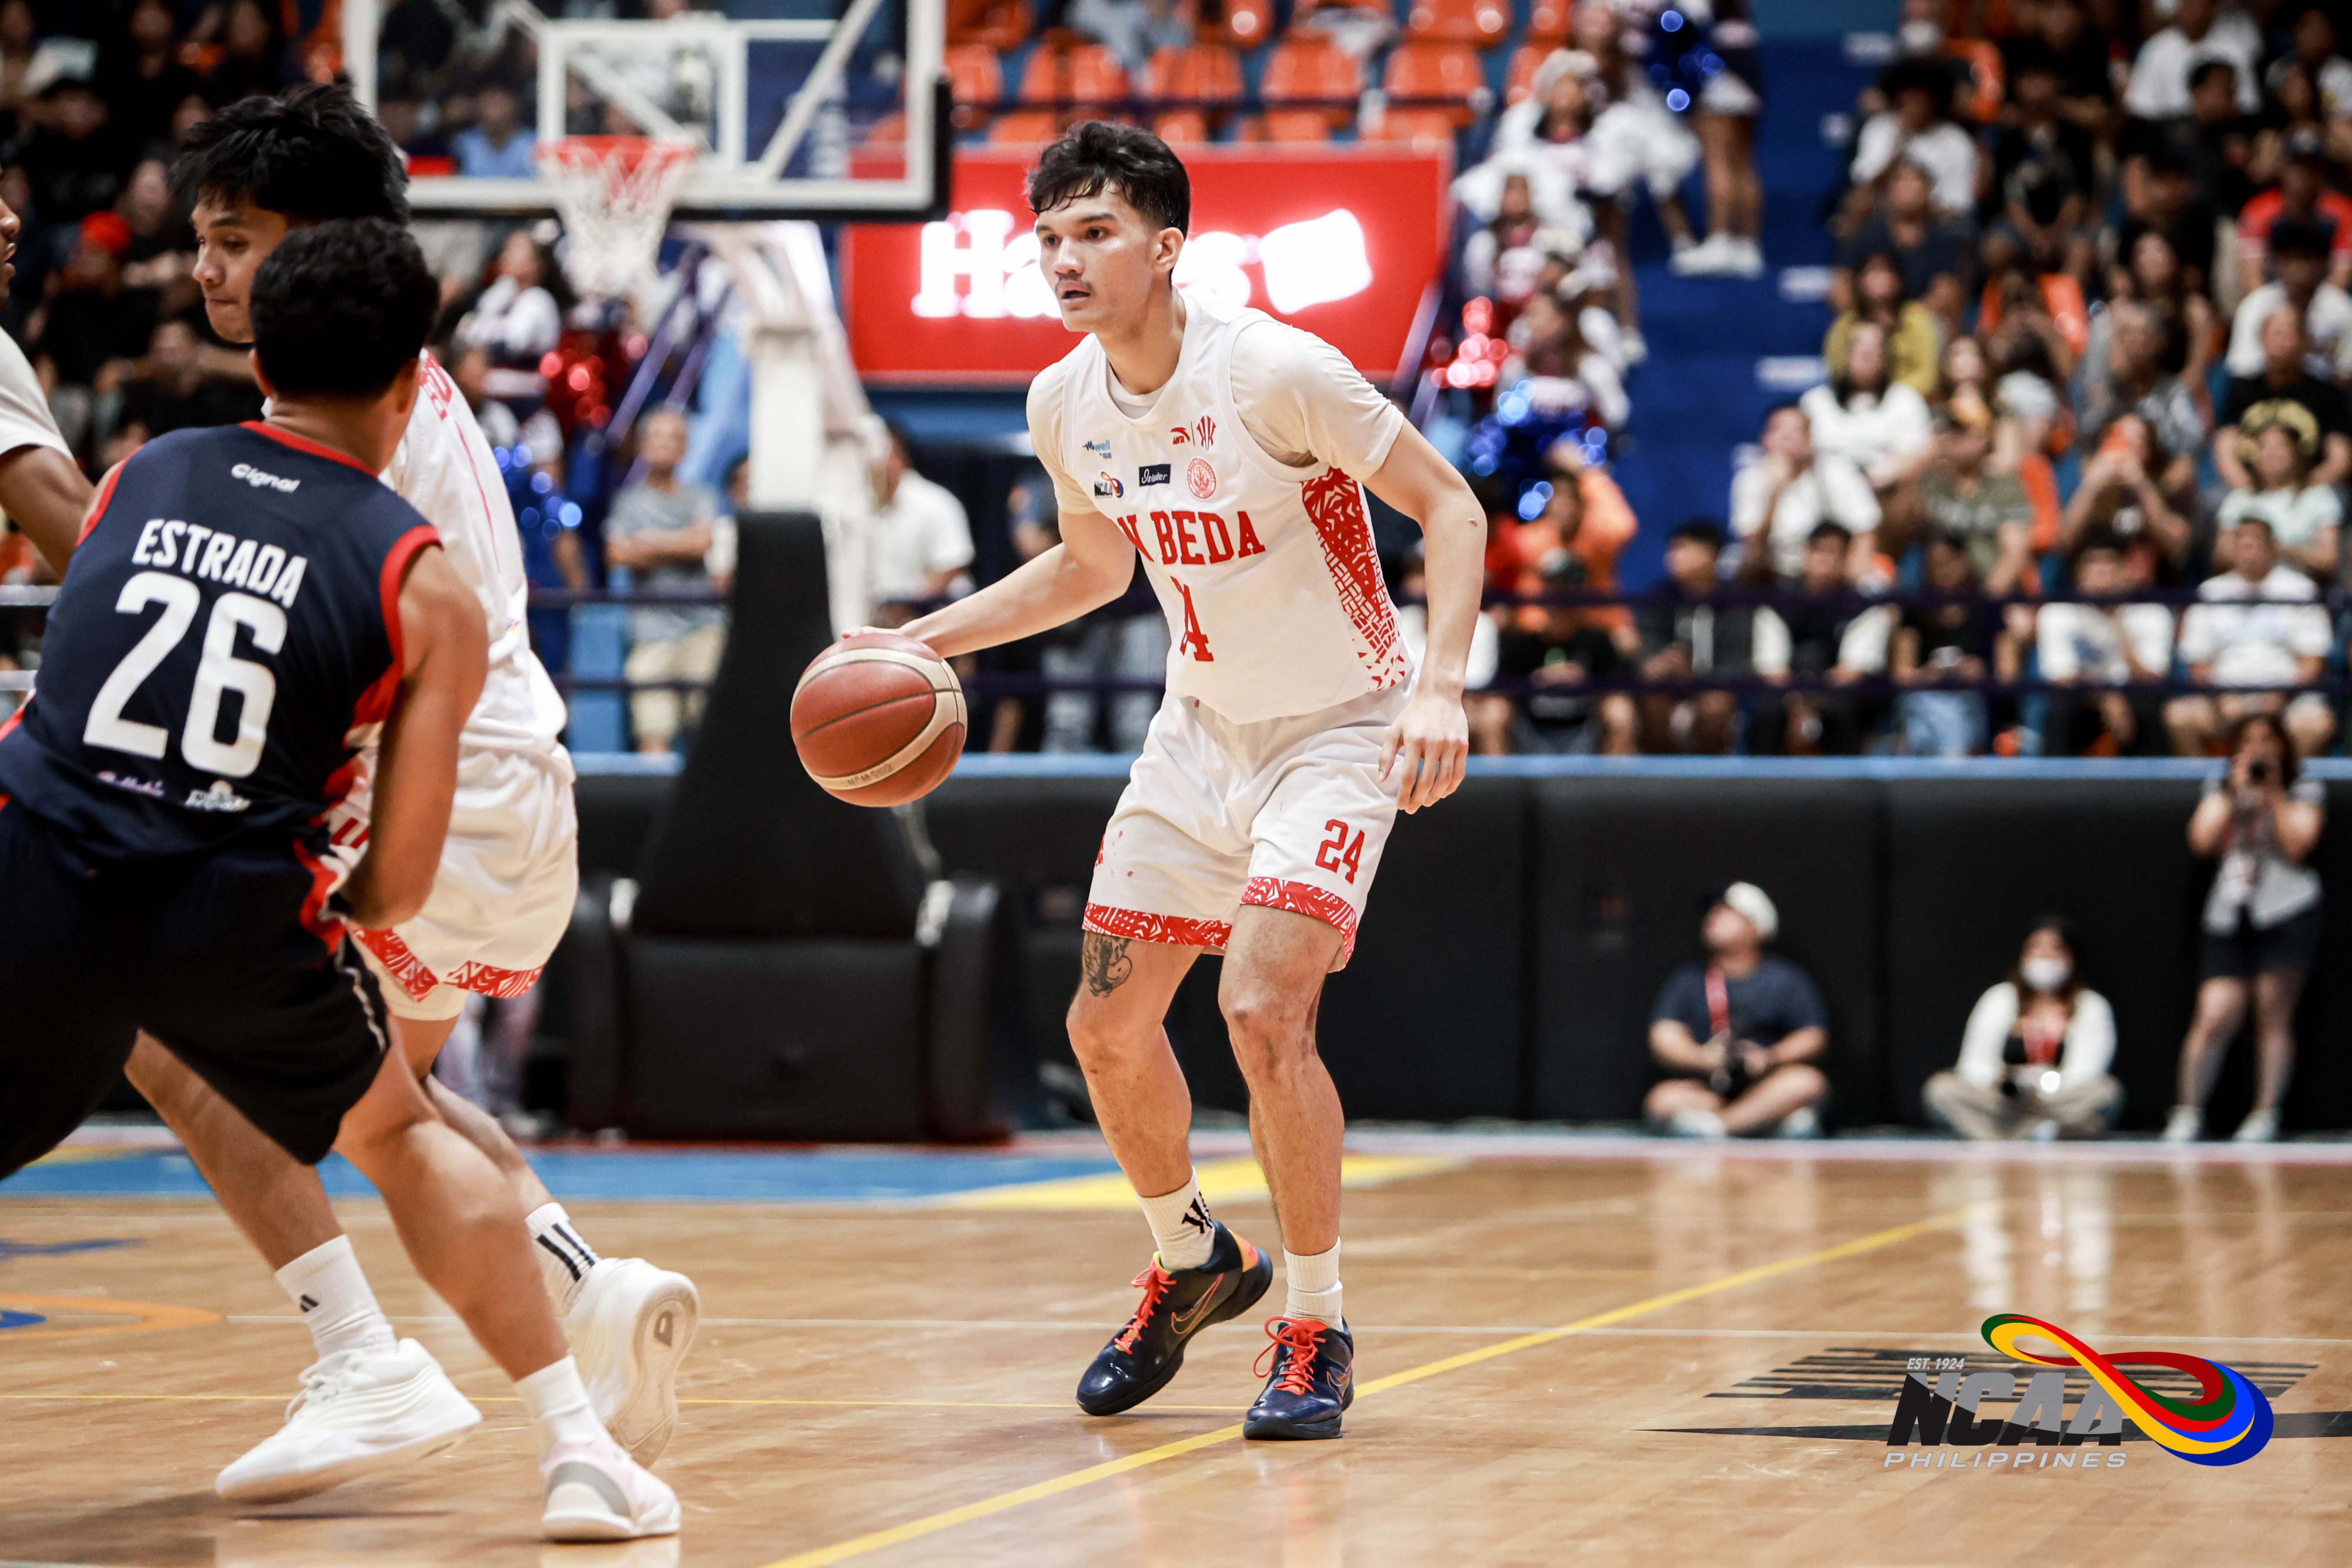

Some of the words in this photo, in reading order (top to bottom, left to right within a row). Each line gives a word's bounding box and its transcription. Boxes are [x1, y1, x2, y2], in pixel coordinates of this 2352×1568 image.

[231, 463, 301, 493] Cignal
[132, 519, 307, 608] ESTRADA
[1150, 510, 1266, 565] BEDA
[83, 570, 288, 778] 26
[1315, 819, 1365, 885] 24
